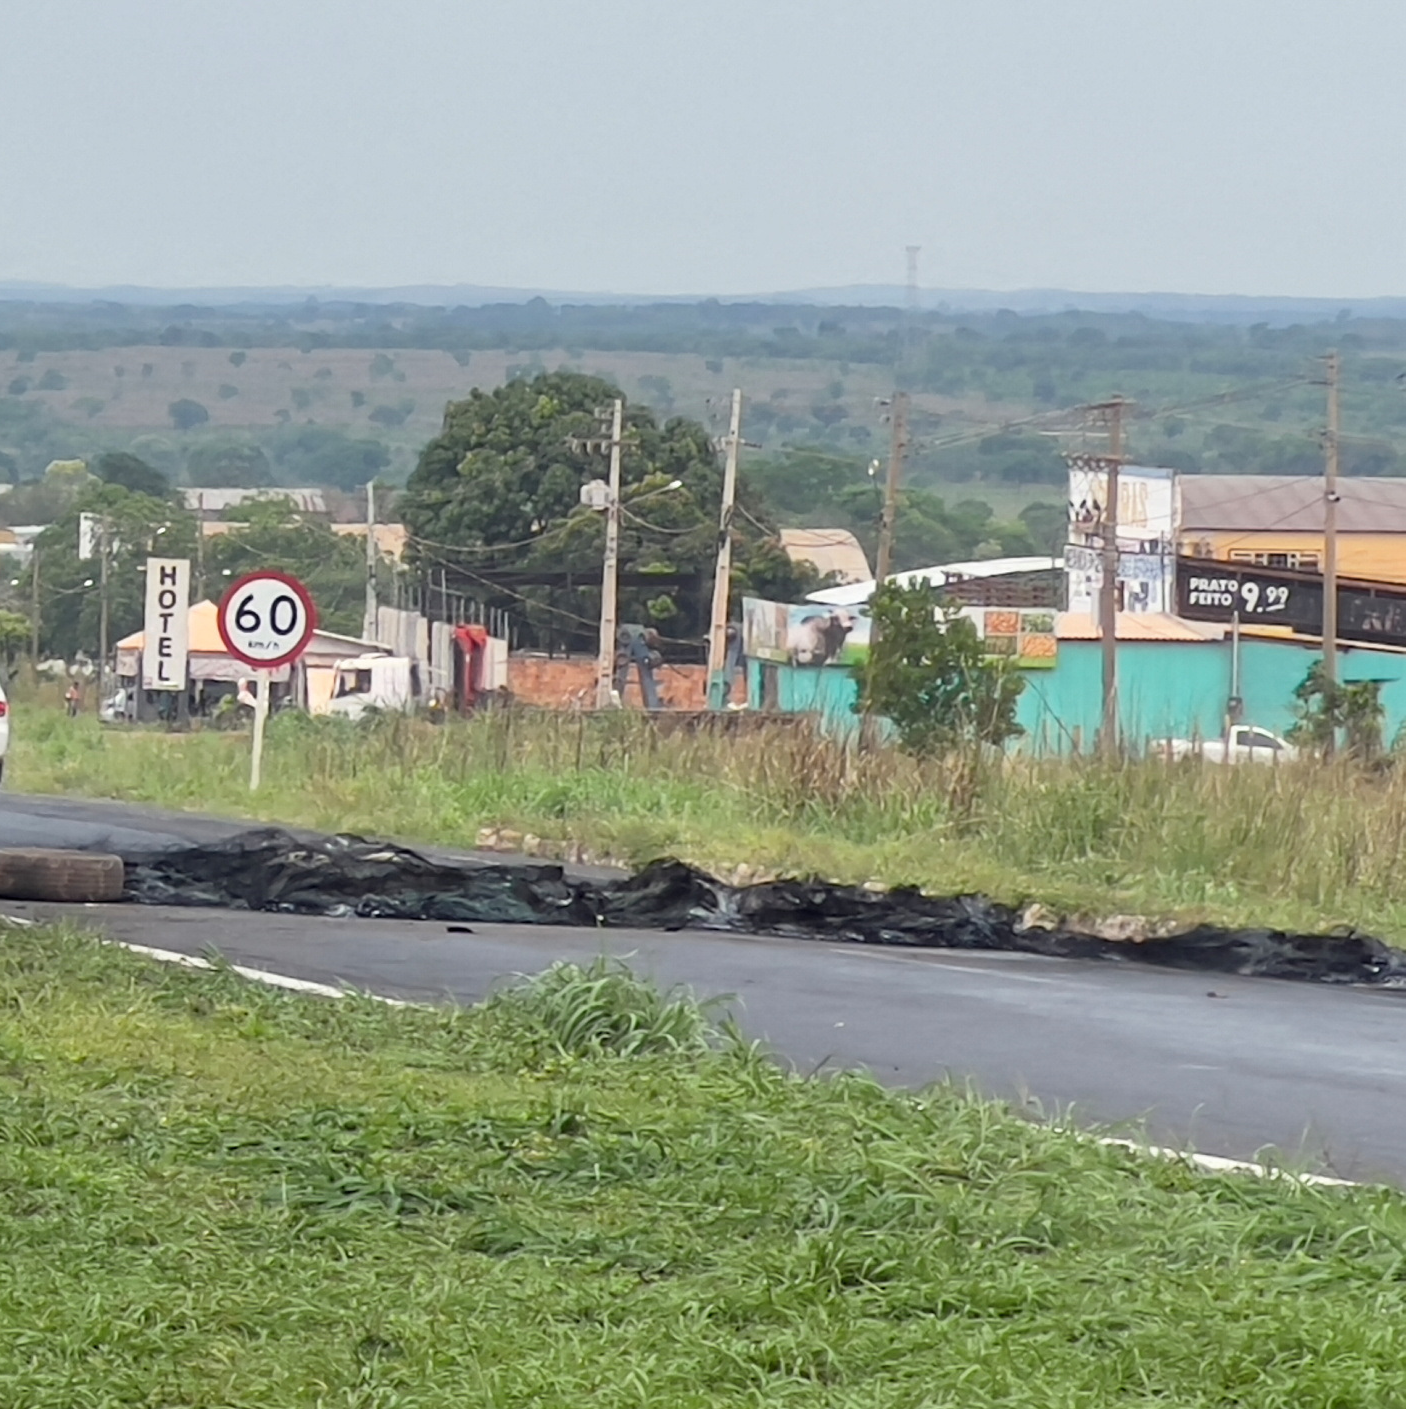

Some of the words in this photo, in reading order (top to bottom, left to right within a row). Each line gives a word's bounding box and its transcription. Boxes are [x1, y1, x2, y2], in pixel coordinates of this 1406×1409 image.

[1189, 577, 1238, 593] PRATO
[1241, 581, 1289, 613] 9.99
[1189, 592, 1232, 607] FEITO
[157, 565, 177, 682] HOTEL
[235, 593, 298, 636] 60
[247, 639, 280, 651] km/h
